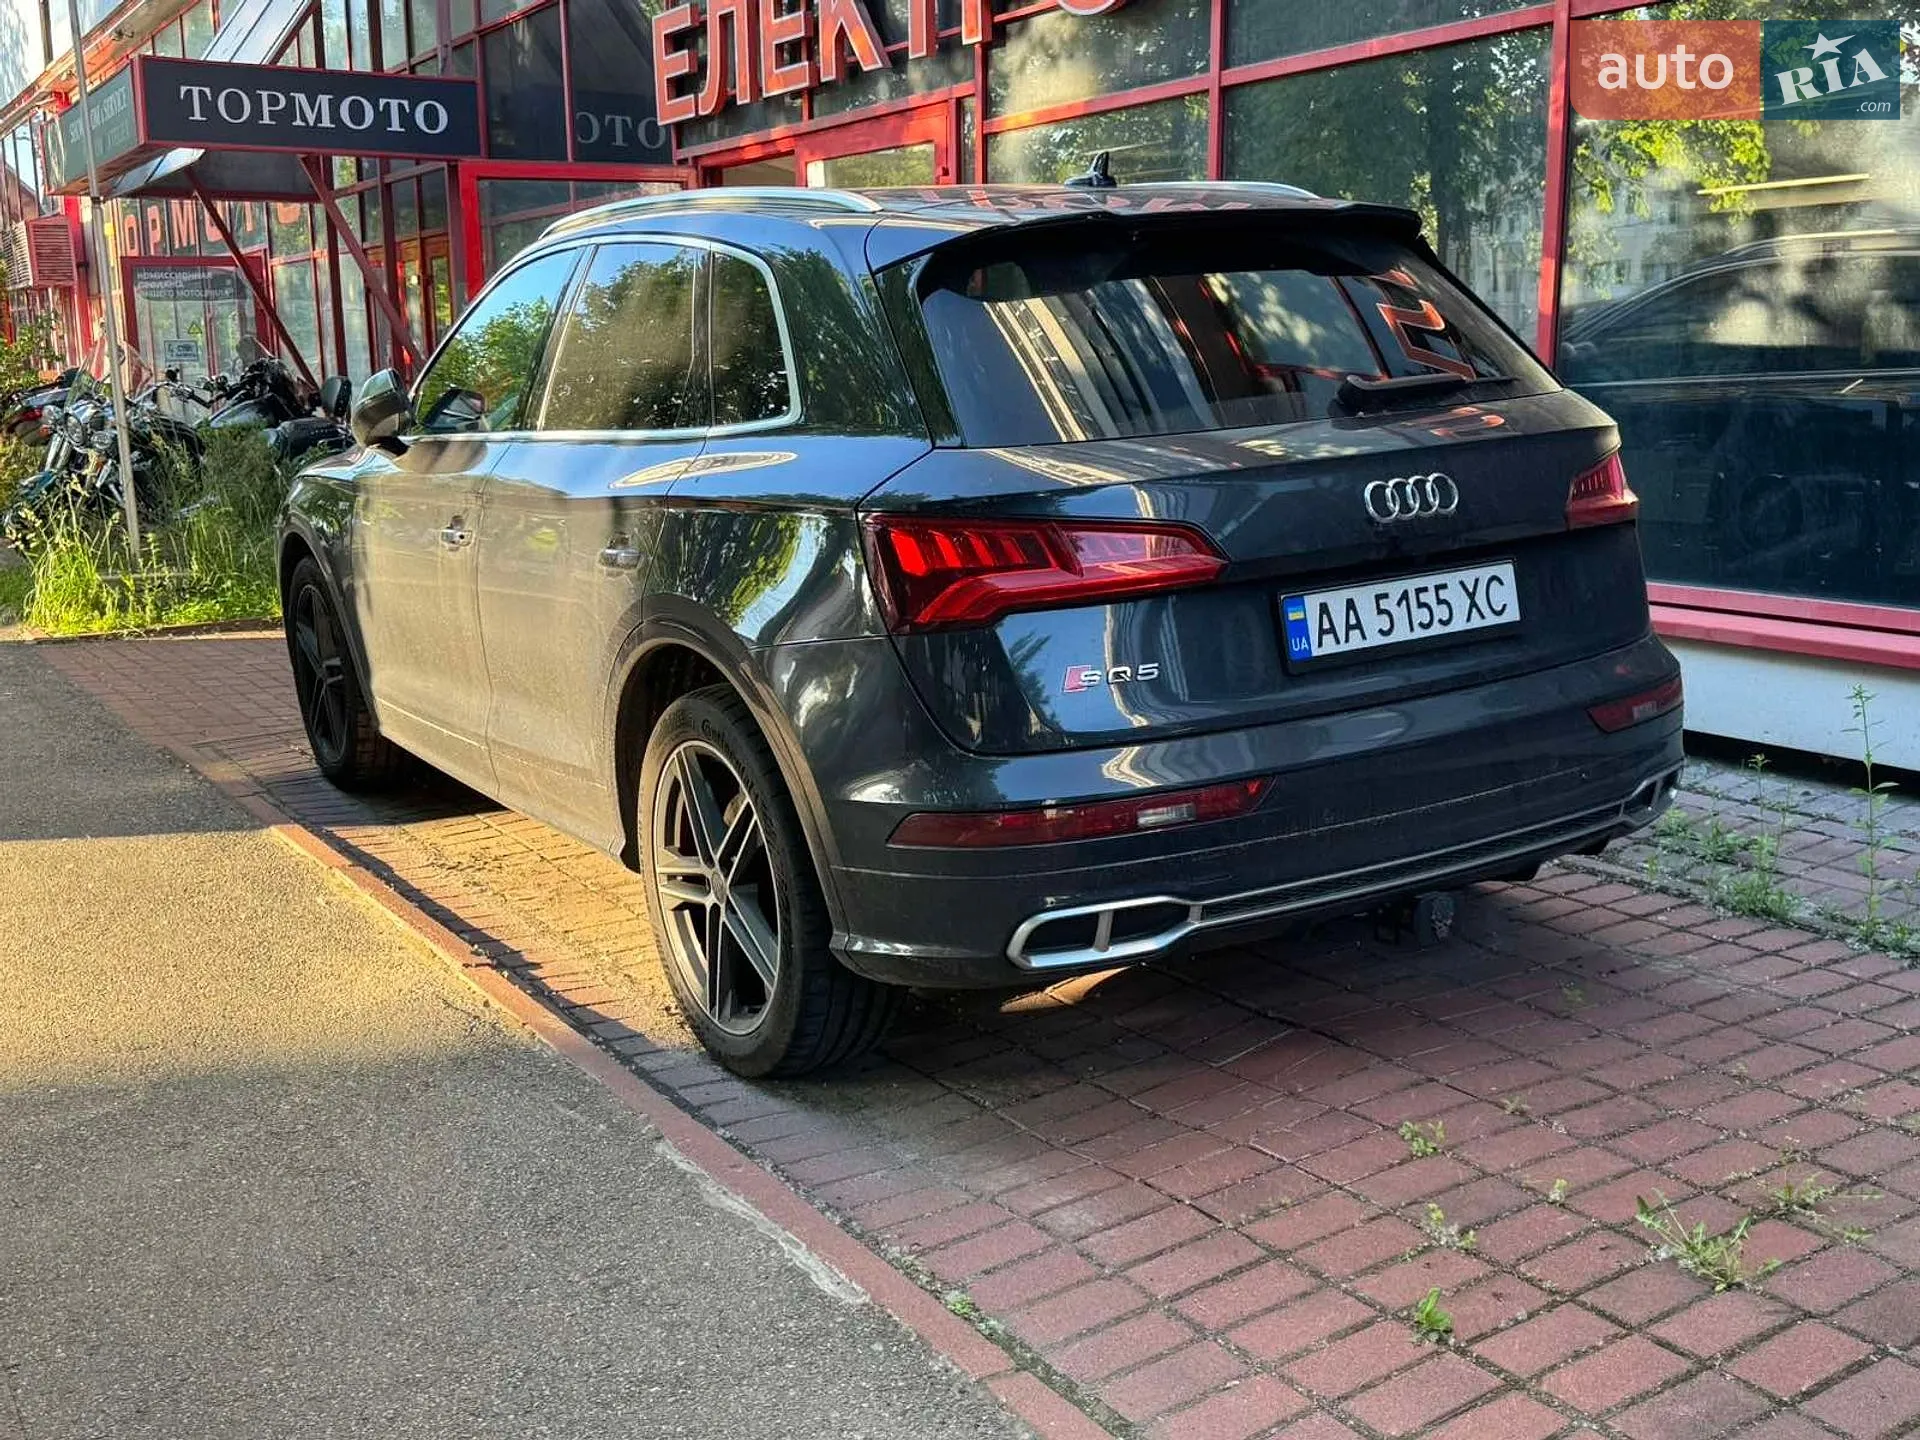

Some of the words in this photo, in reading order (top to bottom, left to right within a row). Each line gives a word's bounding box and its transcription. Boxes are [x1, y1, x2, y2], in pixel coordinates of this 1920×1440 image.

[652, 0, 1121, 126] ЕЛЕК
[180, 85, 449, 135] TOPMOTO
[1317, 601, 1367, 648] AA
[1374, 583, 1455, 637] 5155
[1459, 574, 1508, 623] XC
[1291, 636, 1309, 652] UA
[1078, 662, 1159, 687] SQ5
